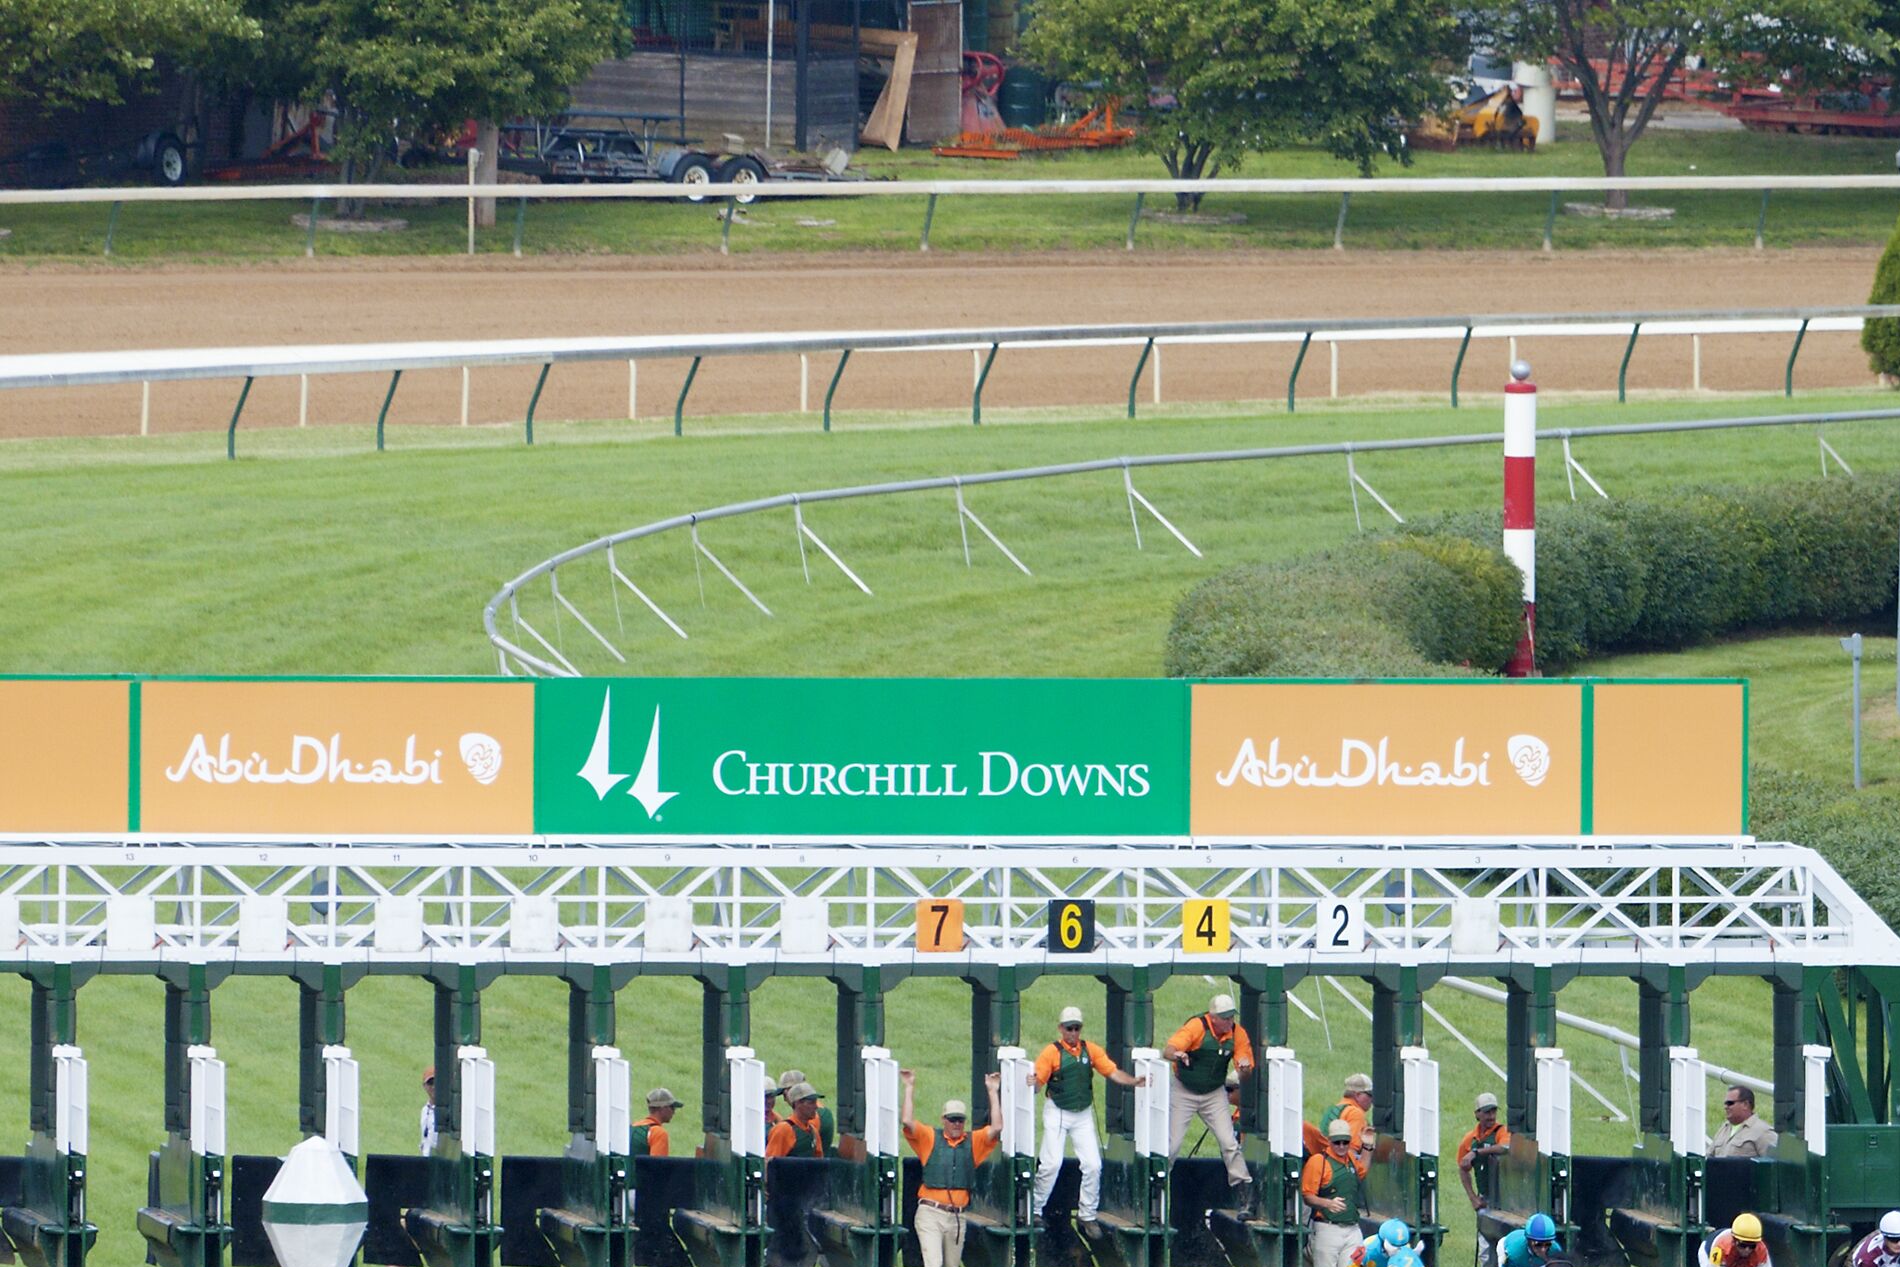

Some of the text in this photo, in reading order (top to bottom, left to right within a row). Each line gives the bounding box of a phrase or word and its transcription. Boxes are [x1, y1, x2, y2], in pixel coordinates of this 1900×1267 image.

[712, 750, 1150, 797] CHURCHILL DOWNS
[125, 853, 135, 861] 13
[259, 853, 269, 862] 12
[393, 854, 401, 862] 11
[527, 854, 538, 862] 10
[664, 853, 671, 862] 9
[935, 854, 942, 862] 7
[1072, 856, 1079, 864] 6
[1206, 855, 1212, 864] 5
[1337, 855, 1344, 864] 4
[1474, 856, 1481, 864] 3
[1606, 855, 1613, 864] 2
[930, 905, 949, 946] 7
[1060, 903, 1083, 949] 6
[1196, 905, 1216, 946] 4
[1332, 904, 1349, 947] 2
